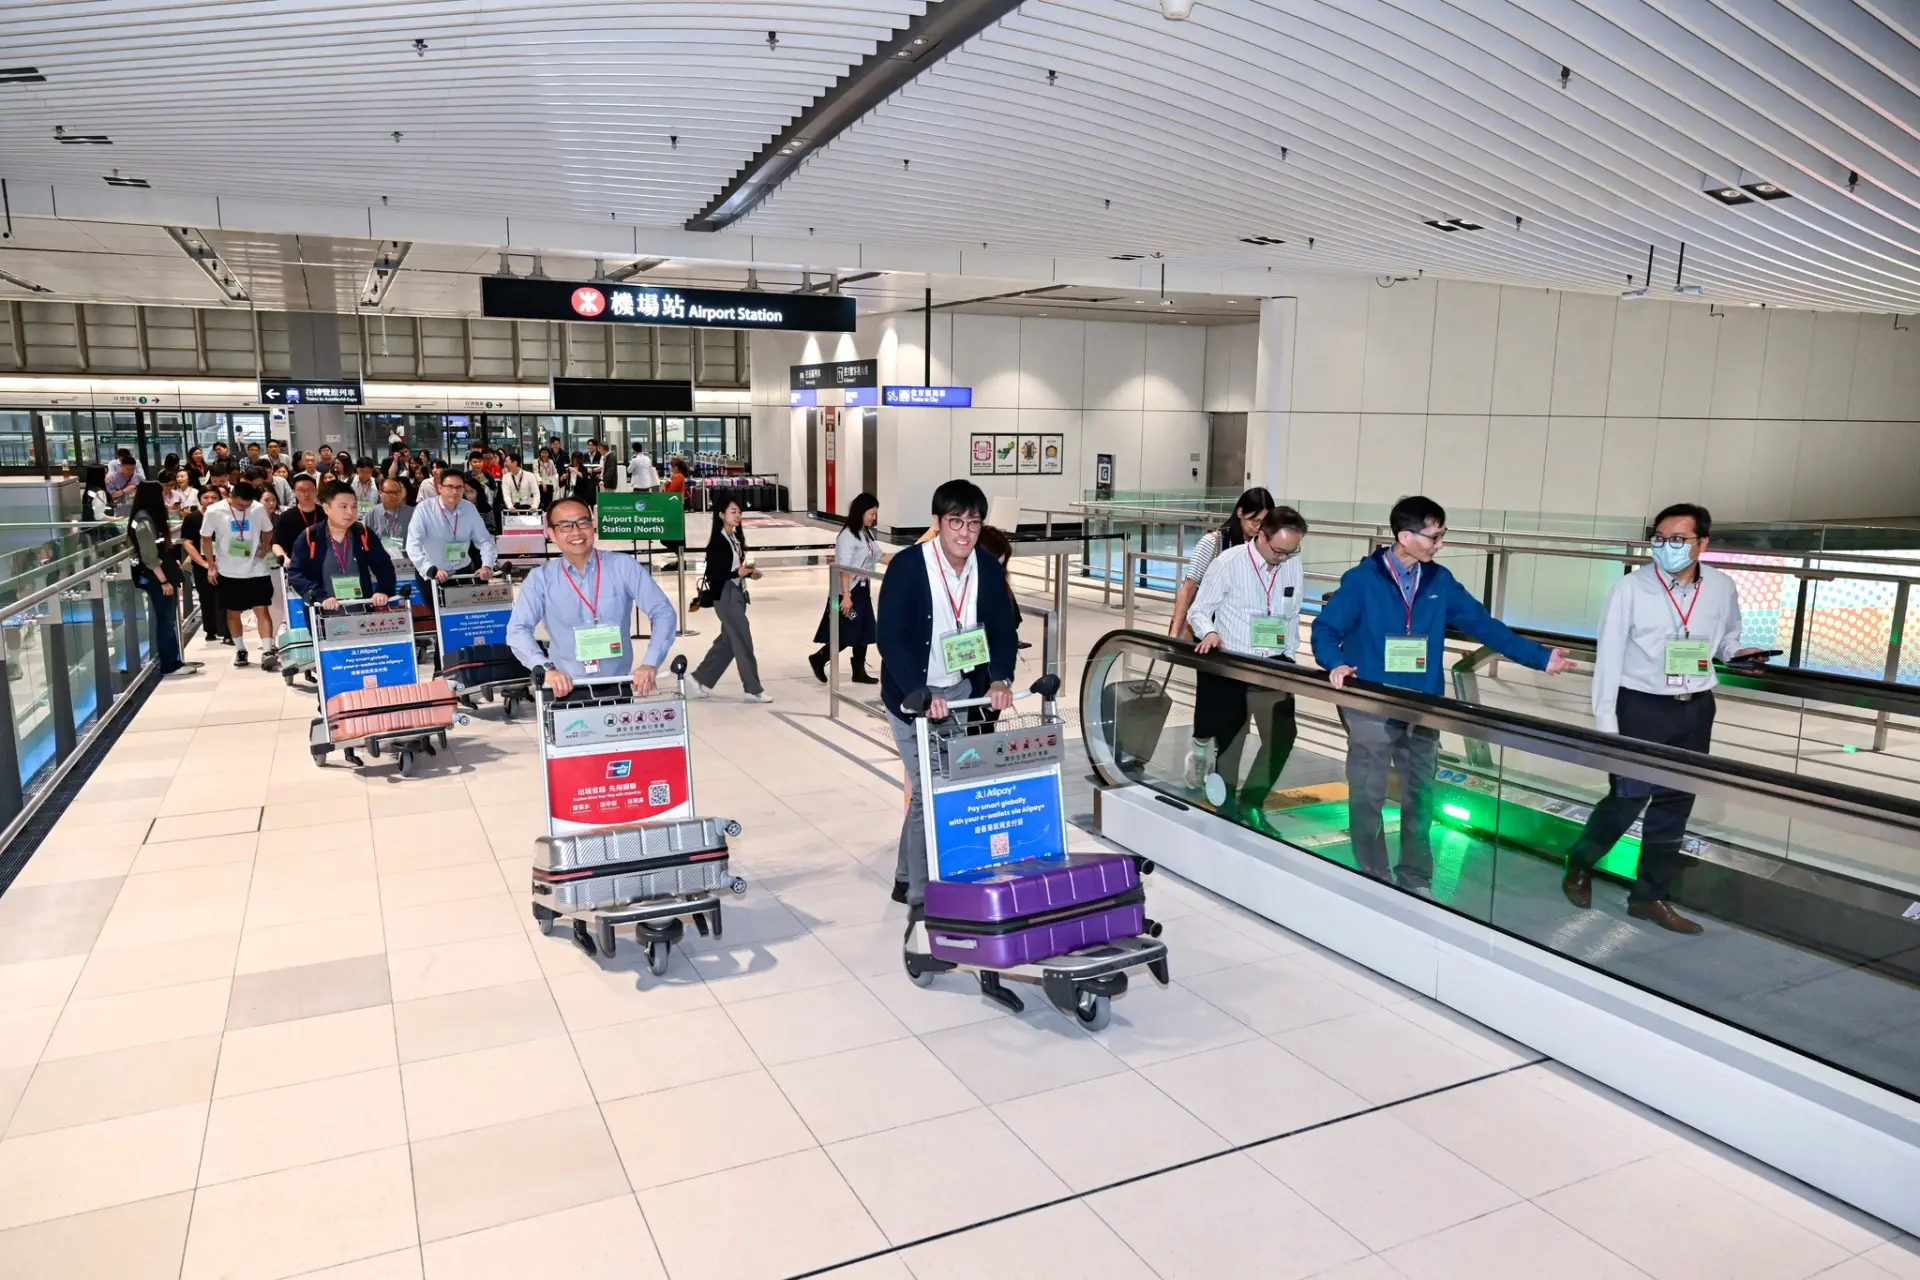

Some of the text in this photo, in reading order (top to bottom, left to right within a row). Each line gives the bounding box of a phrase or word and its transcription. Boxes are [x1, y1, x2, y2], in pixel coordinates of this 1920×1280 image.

[610, 291, 685, 318] 機場站
[688, 304, 782, 322] Airport Station
[602, 516, 664, 524] Airport Express
[634, 526, 664, 534] (North)
[987, 784, 1016, 797] Alipay+
[1001, 797, 1026, 808] globally
[965, 815, 979, 825] your
[980, 810, 1010, 820] e-wallets
[1022, 804, 1045, 813] Alipay+
